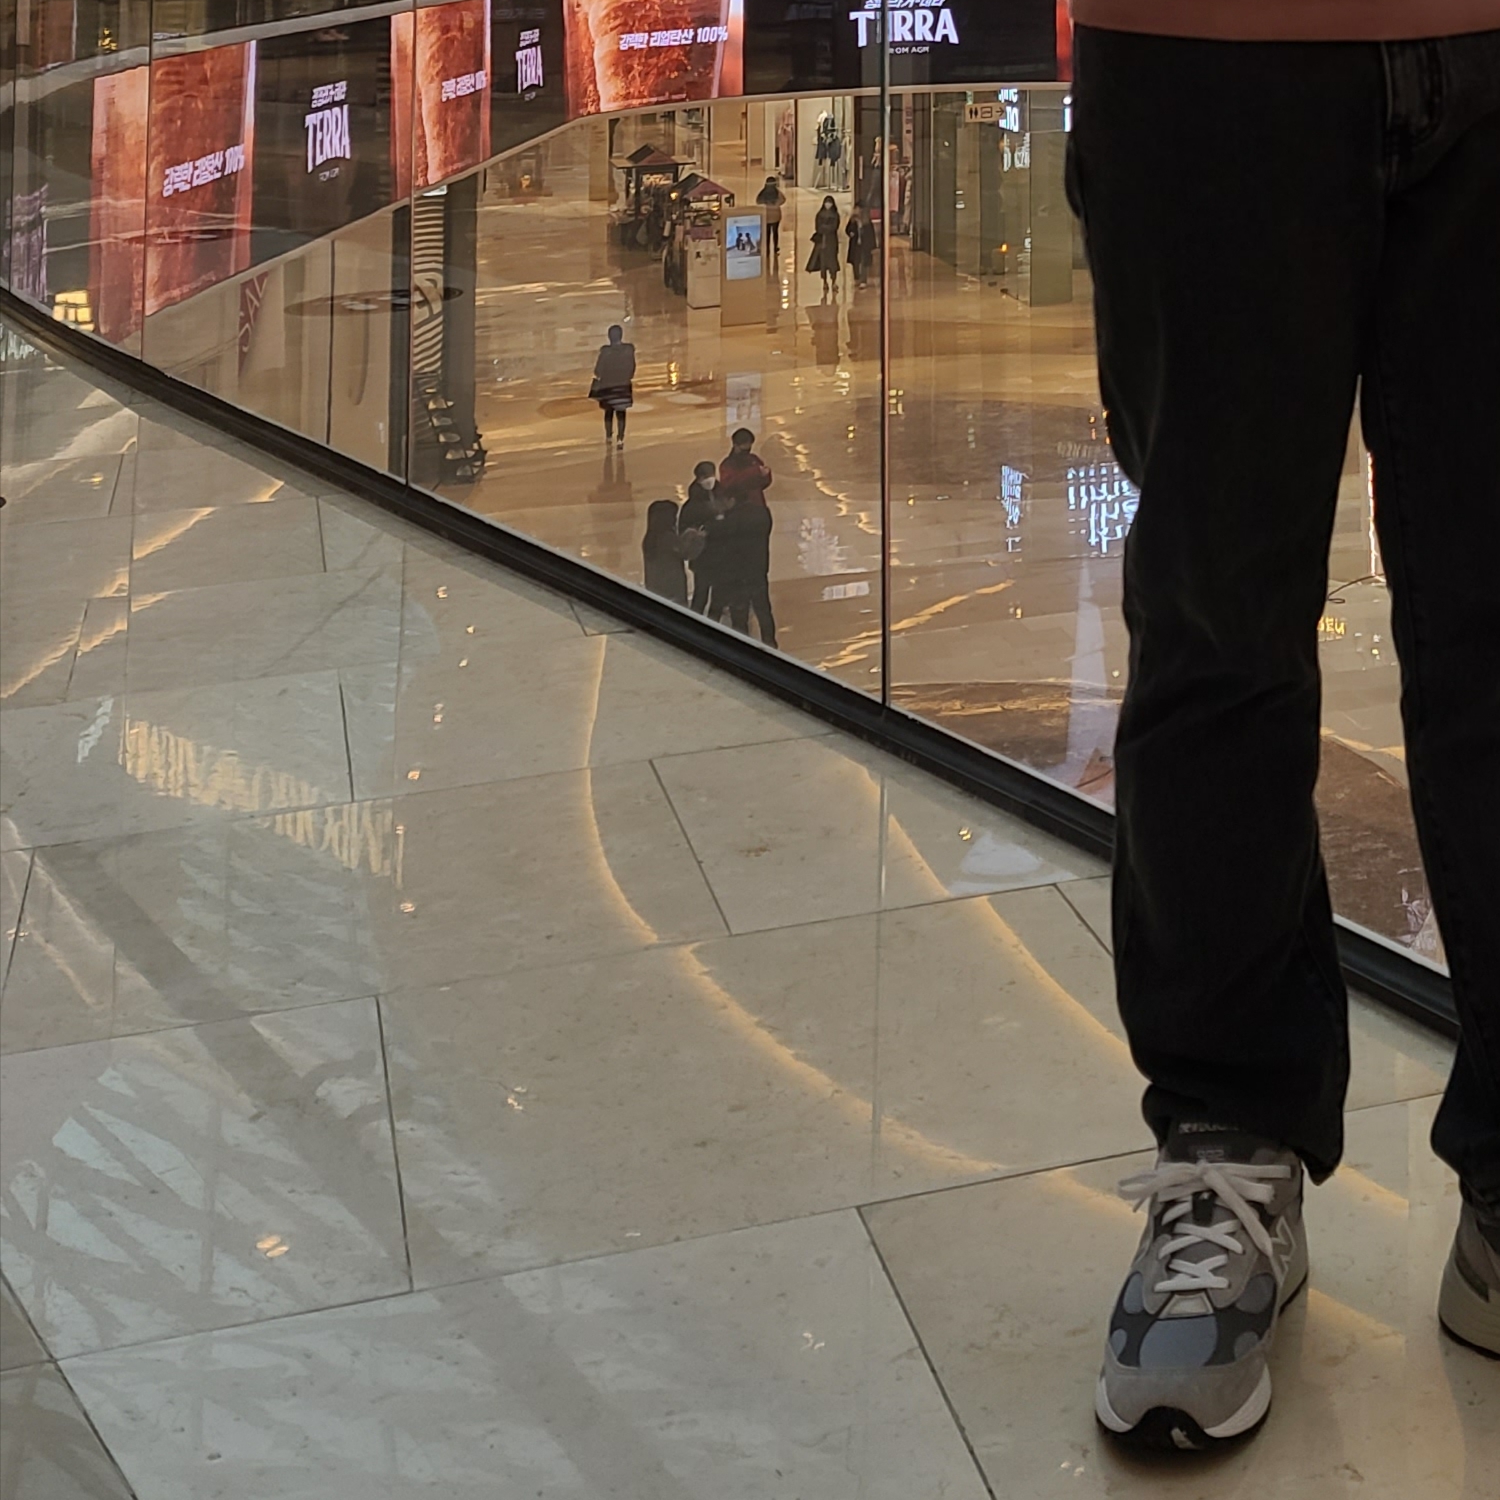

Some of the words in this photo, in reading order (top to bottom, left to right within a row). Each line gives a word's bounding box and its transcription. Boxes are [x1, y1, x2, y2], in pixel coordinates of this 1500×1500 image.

[649, 28, 694, 48] 리얼탄산
[696, 25, 728, 43] 100%
[305, 104, 351, 173] TERRA
